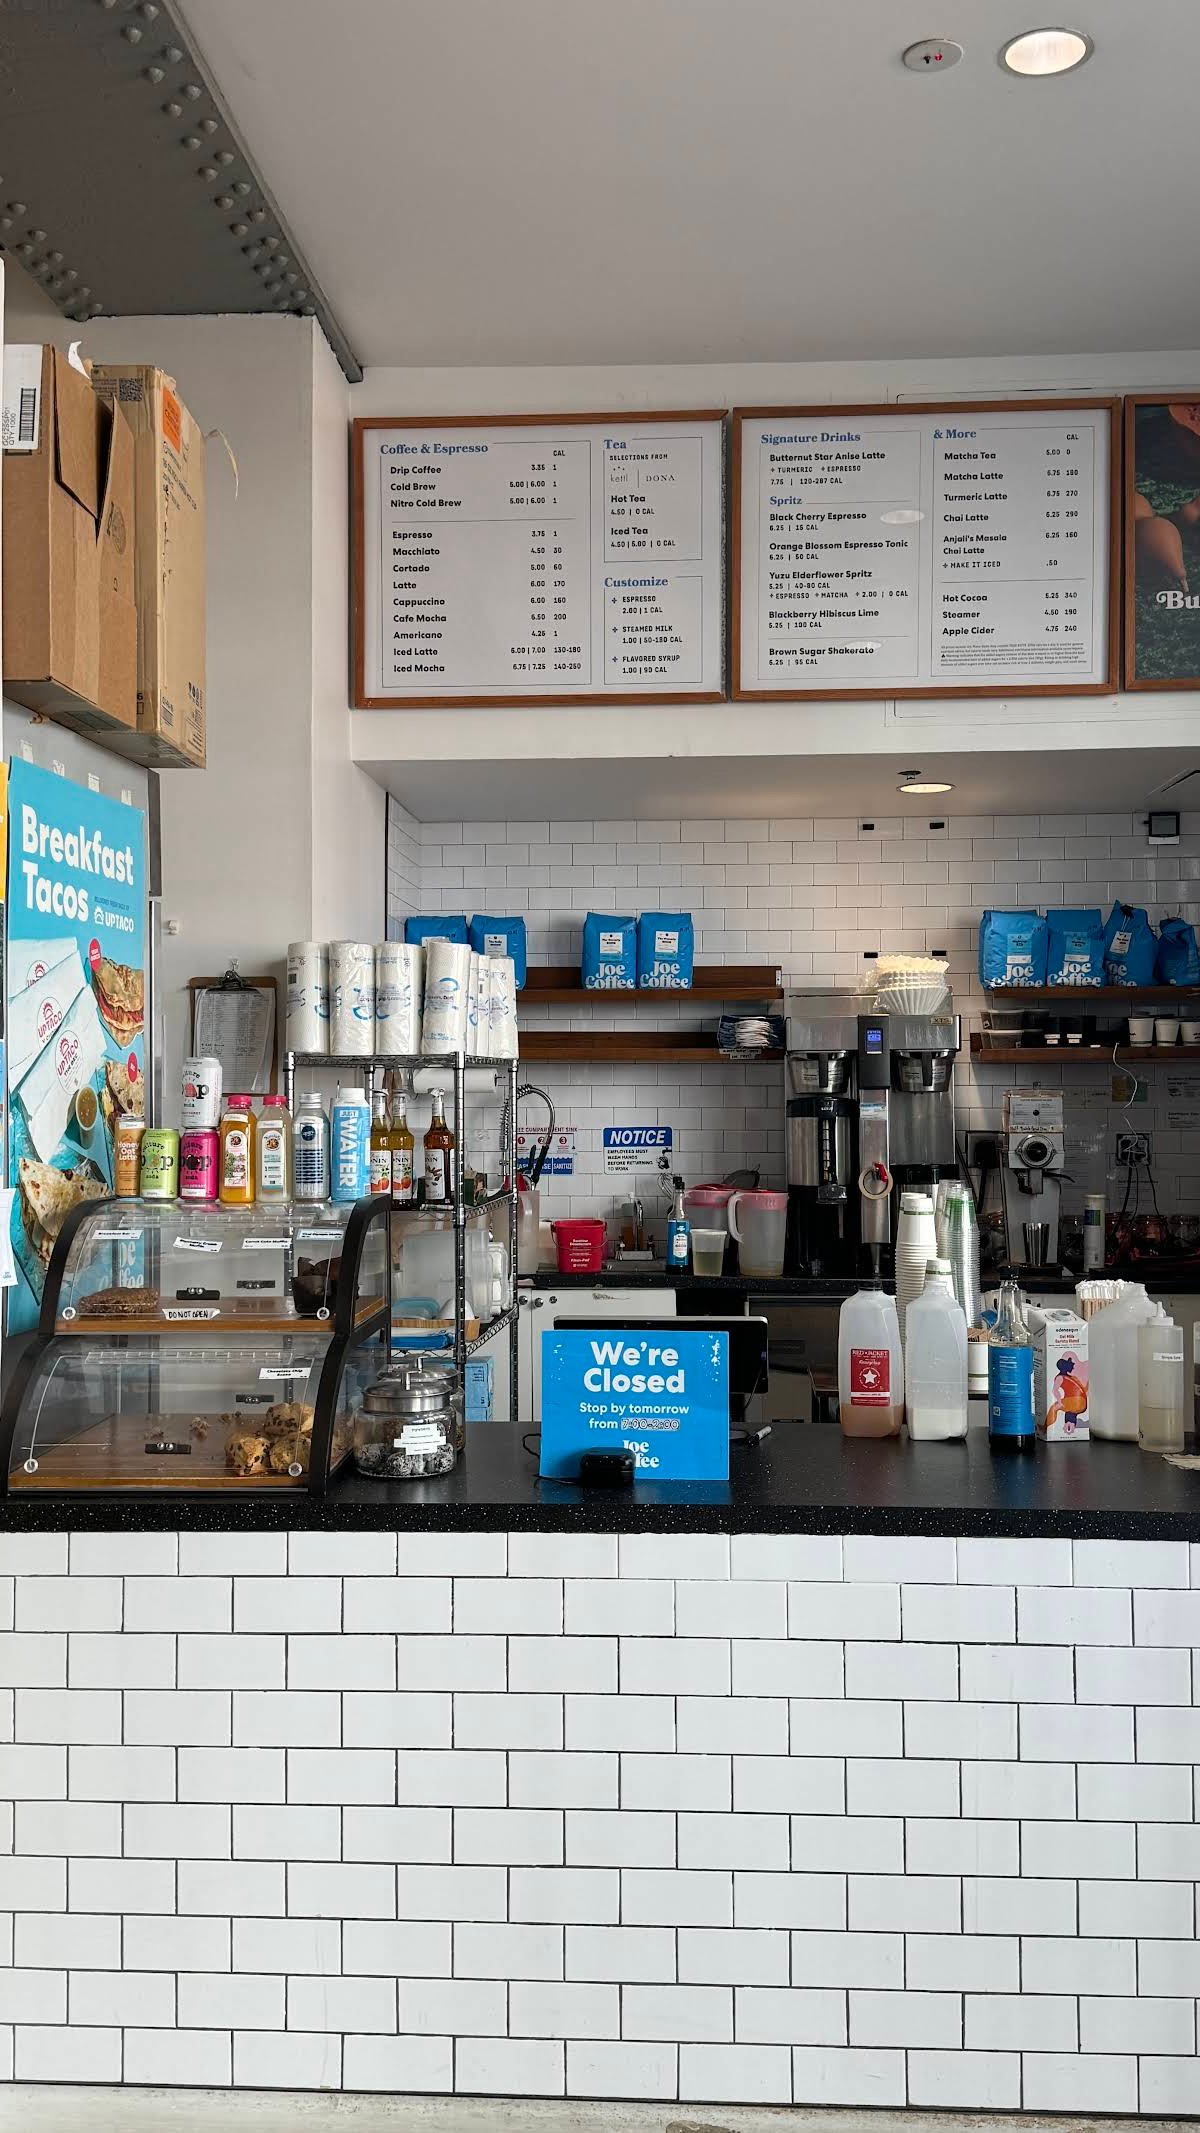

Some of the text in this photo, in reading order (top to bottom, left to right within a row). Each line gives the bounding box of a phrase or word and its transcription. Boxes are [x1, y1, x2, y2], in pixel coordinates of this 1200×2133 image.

[761, 432, 860, 445] Signature Drinks
[934, 429, 976, 439] & More
[380, 444, 488, 455] Coffee & Espresso
[604, 440, 626, 449] Tea
[390, 466, 441, 475] Drip Coffee
[390, 483, 410, 491] Cold
[770, 496, 802, 506] Spritz
[944, 493, 982, 501] Turmeric
[796, 513, 825, 521] Cherry
[828, 513, 866, 521] Espresso
[392, 531, 432, 540] Espresso
[944, 534, 1007, 544] Anjali's Masala
[770, 543, 803, 551] Orange
[844, 542, 883, 550] Espresso
[393, 548, 440, 556] Macchiato
[846, 570, 872, 578] Spritz
[604, 577, 668, 587] Customize
[393, 598, 445, 608] Cappuccino
[1156, 590, 1200, 609] Bu
[394, 614, 447, 623] Cafe Mocha
[769, 609, 879, 619] Blackberry Hibiscus Lime
[394, 631, 442, 639] Americano
[943, 628, 968, 636] Apple
[394, 648, 438, 656] Iced Latte
[800, 648, 825, 656] Sugar
[394, 664, 445, 673] Iced Mocha
[22, 804, 133, 886] Breakfast
[23, 860, 88, 922] Tacos
[105, 912, 134, 932] UPTACO
[596, 963, 625, 978] Joe
[650, 961, 680, 976] Joe
[1002, 965, 1034, 980] Joe
[1058, 961, 1091, 976] Joe
[585, 976, 634, 989] Coffee
[640, 974, 688, 989] Coffee
[1047, 973, 1101, 987] Coffee
[37, 1011, 62, 1038] UPTACO
[57, 1040, 79, 1076] UPTACO
[610, 1130, 666, 1144] NOTICE
[340, 1118, 358, 1186] WATER
[168, 1311, 178, 1319] DO
[192, 1310, 208, 1318] OPEN
[591, 1341, 678, 1366] We’re
[584, 1368, 685, 1393] Closed
[580, 1402, 689, 1415] Stop by tomorrow
[589, 1418, 679, 1429] from 7:00-2:00
[635, 1453, 660, 1468] fee
